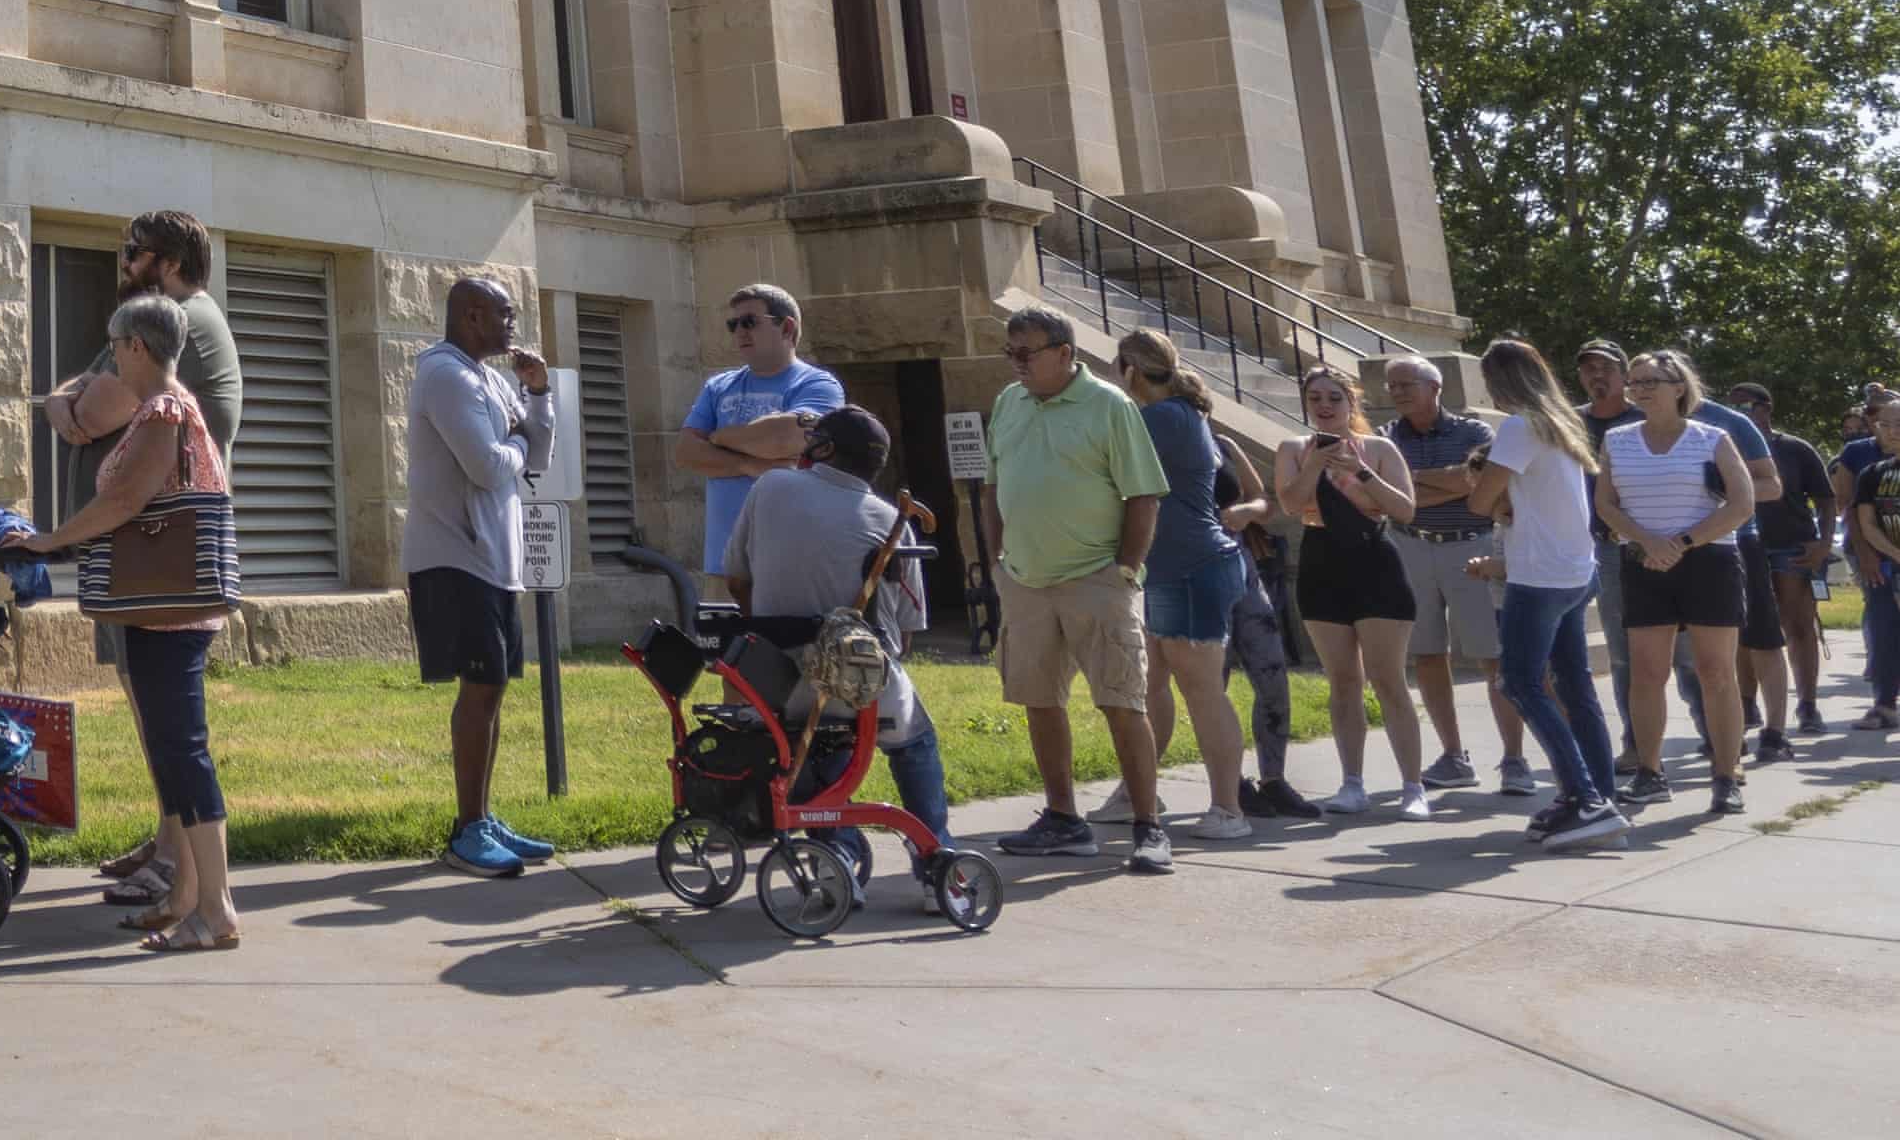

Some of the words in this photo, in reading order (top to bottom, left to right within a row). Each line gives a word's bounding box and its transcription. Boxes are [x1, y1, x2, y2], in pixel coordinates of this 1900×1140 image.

[529, 507, 542, 519] NO
[523, 521, 557, 532] MOKING
[528, 544, 548, 555] THIS
[525, 556, 551, 566] POINT
